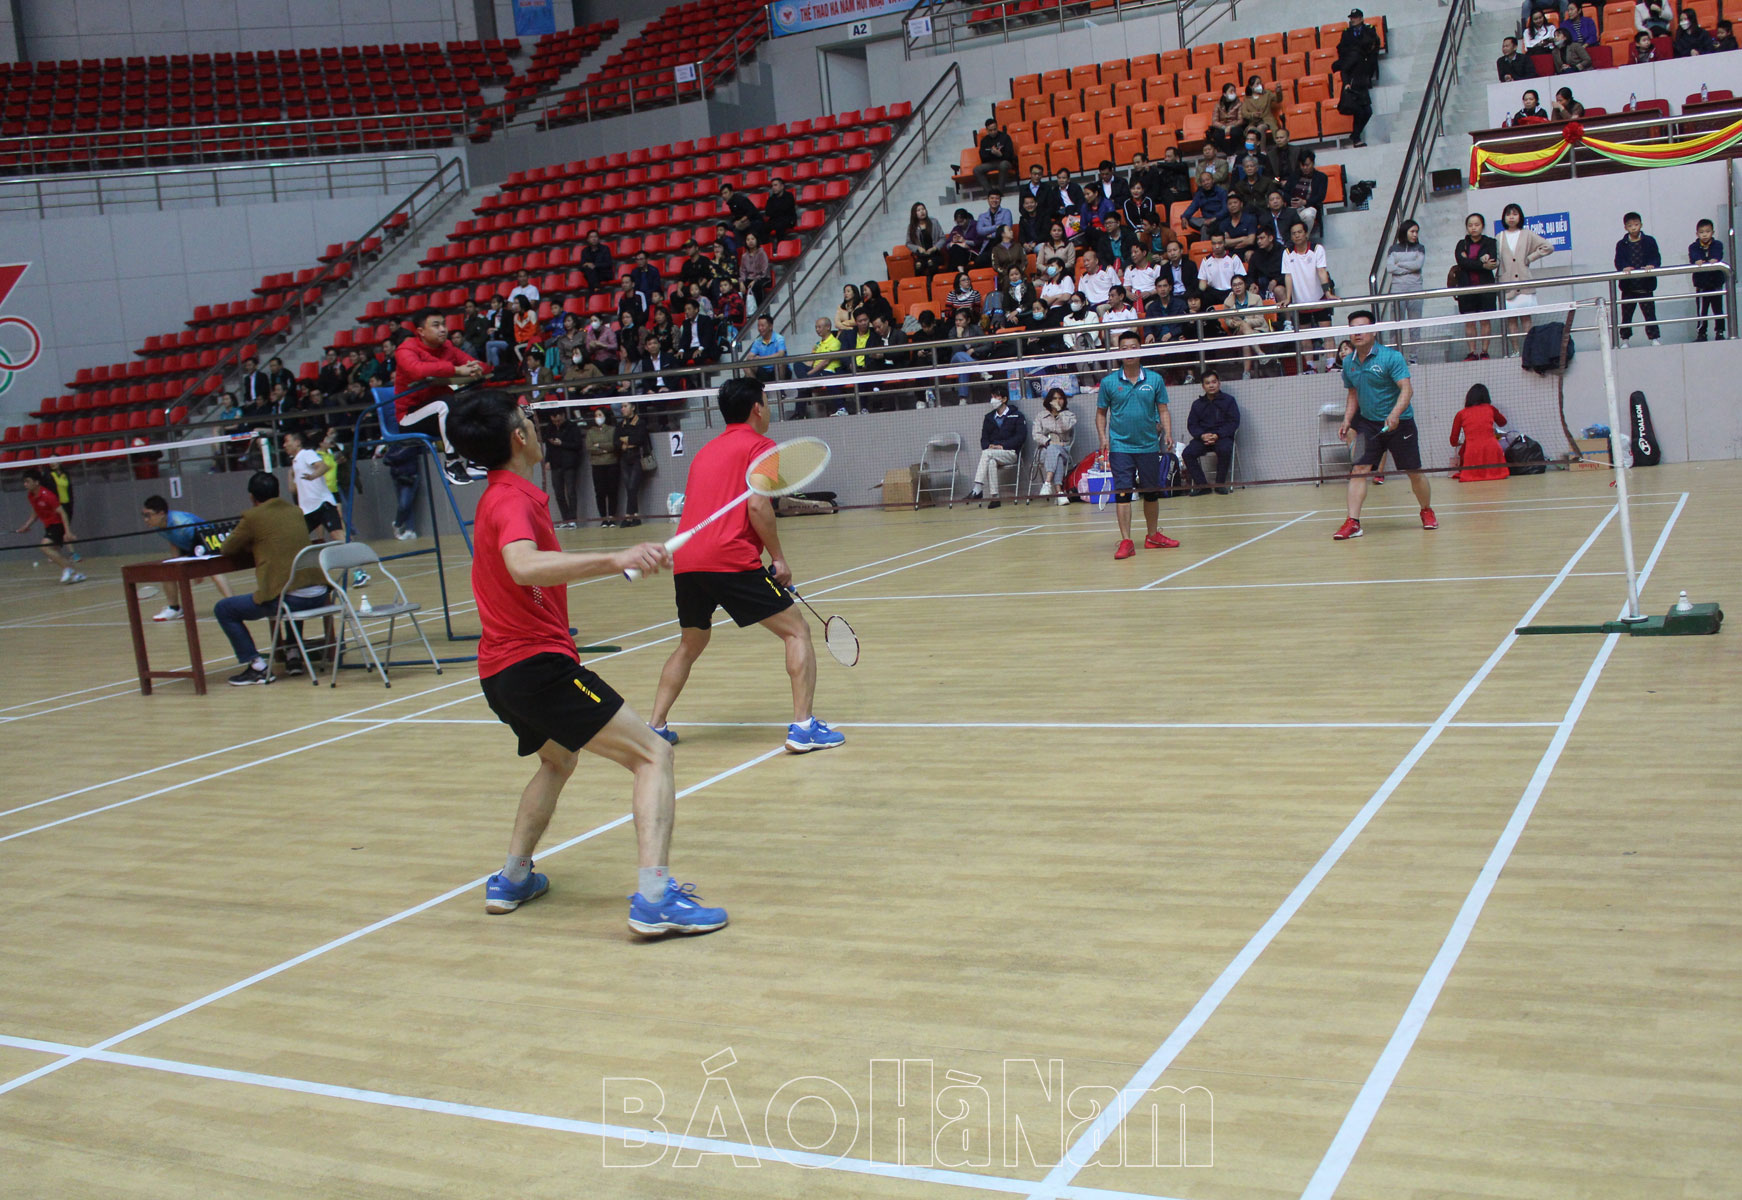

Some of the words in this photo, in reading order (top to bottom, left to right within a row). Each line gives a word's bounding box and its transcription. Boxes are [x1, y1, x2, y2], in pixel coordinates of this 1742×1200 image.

[813, 3, 829, 19] THAO
[853, 24, 867, 36] A2
[1635, 404, 1646, 437] TOALSON
[672, 434, 683, 455] 2
[205, 534, 222, 550] 14
